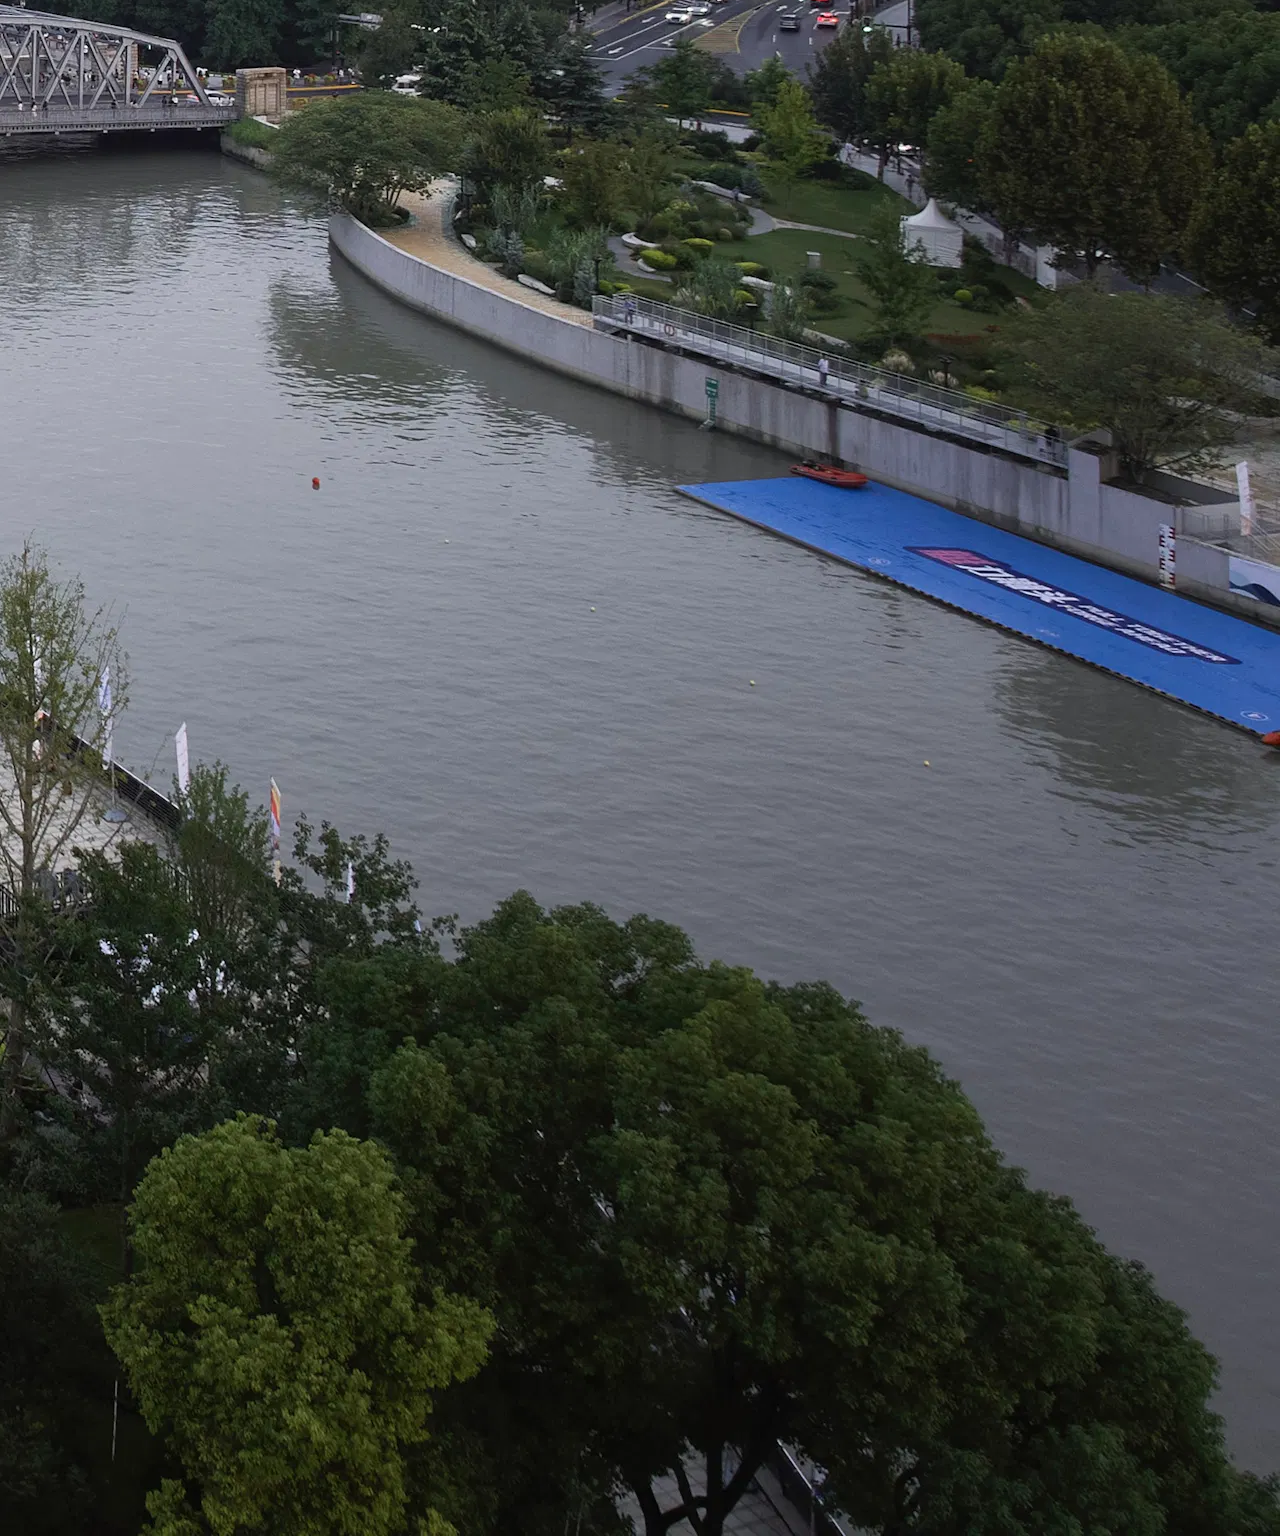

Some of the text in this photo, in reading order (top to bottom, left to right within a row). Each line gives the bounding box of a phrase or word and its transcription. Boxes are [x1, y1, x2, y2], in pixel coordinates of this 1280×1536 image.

[1078, 604, 1227, 662] PULL TOGETHER
[1115, 627, 1187, 654] AHEAD
